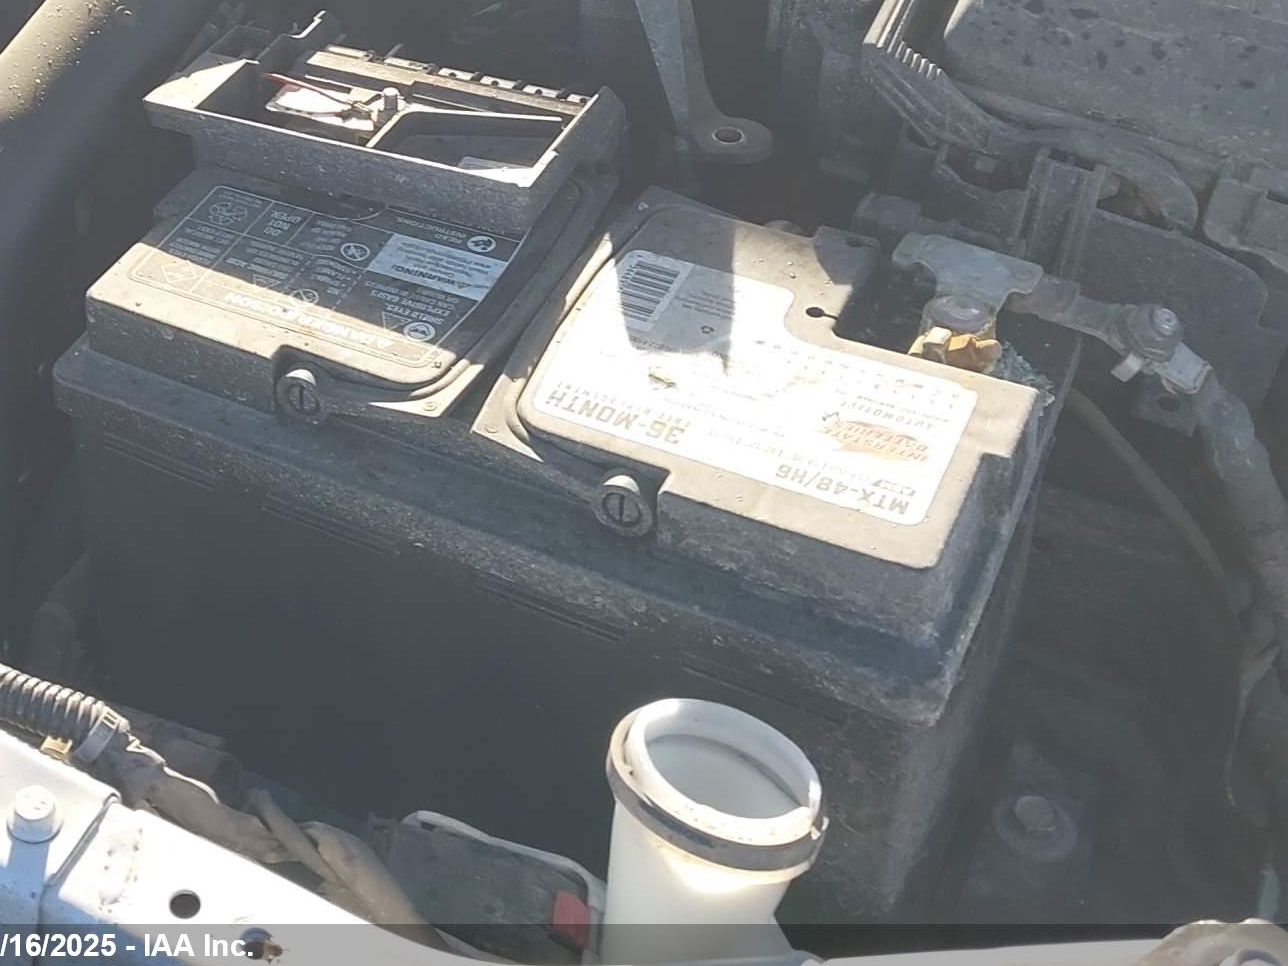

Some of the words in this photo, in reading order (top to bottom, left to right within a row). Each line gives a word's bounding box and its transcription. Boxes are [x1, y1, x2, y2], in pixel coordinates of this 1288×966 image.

[265, 218, 291, 230] NOT
[267, 209, 302, 223] OPEN.
[261, 226, 282, 236] DO
[388, 263, 456, 286] WARNING:
[409, 311, 445, 324] SHIELD
[541, 388, 687, 445] 36-MONTH
[820, 426, 929, 462] INTERSTATE
[775, 462, 911, 516] MTX-48/H6
